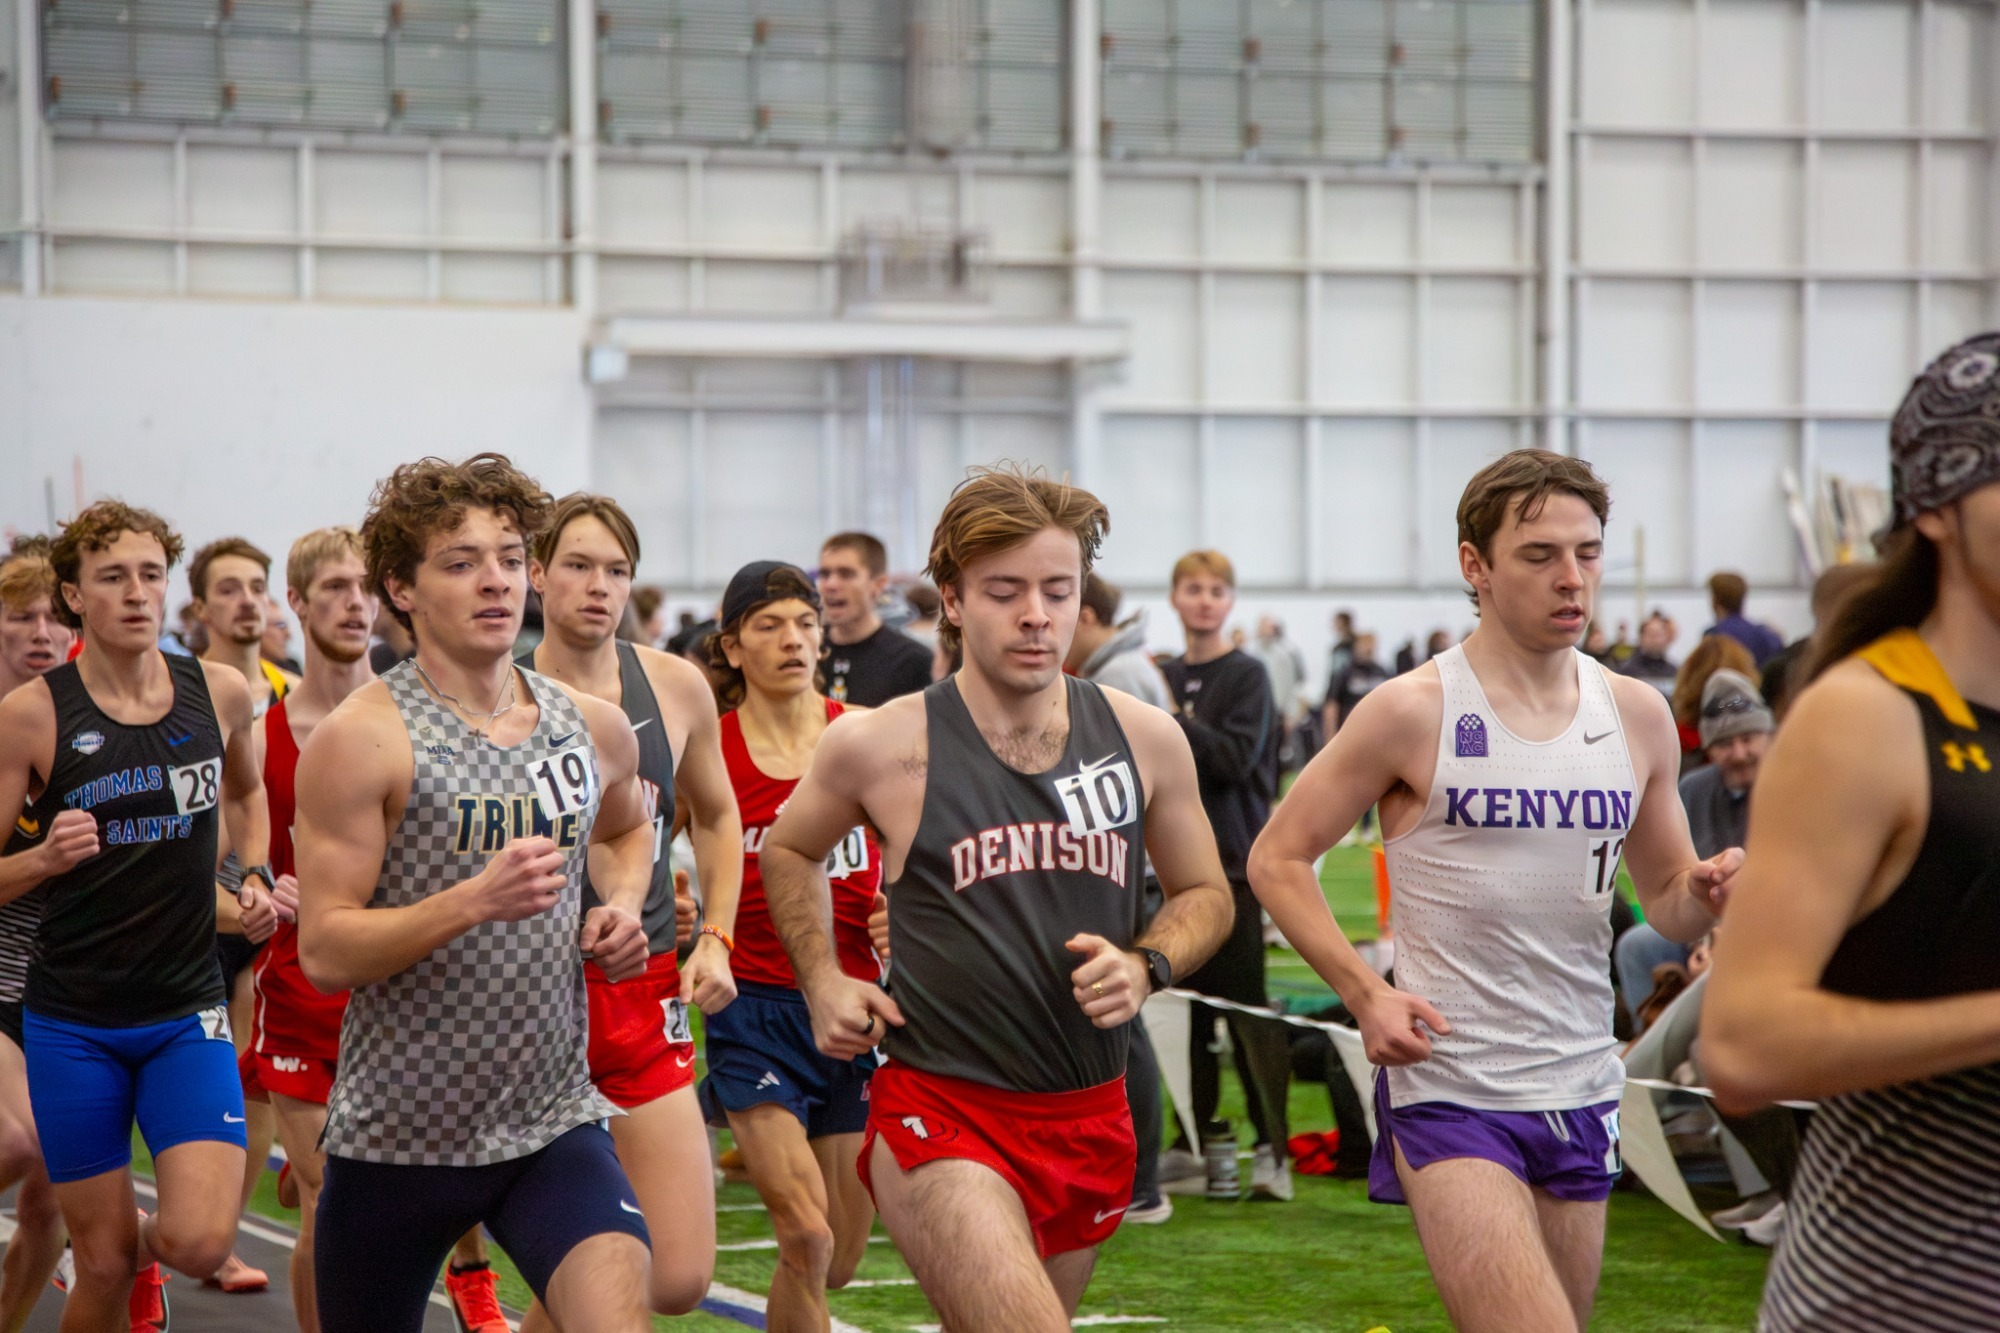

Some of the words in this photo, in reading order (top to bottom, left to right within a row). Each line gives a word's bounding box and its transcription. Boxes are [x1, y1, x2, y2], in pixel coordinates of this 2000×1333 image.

[64, 764, 163, 811] THOMAS
[178, 762, 217, 811] 28
[536, 752, 591, 814] 19
[1065, 769, 1128, 832] 10
[106, 814, 192, 845] SAINTS
[1444, 787, 1632, 830] KENYON
[951, 821, 1128, 893] DENISON
